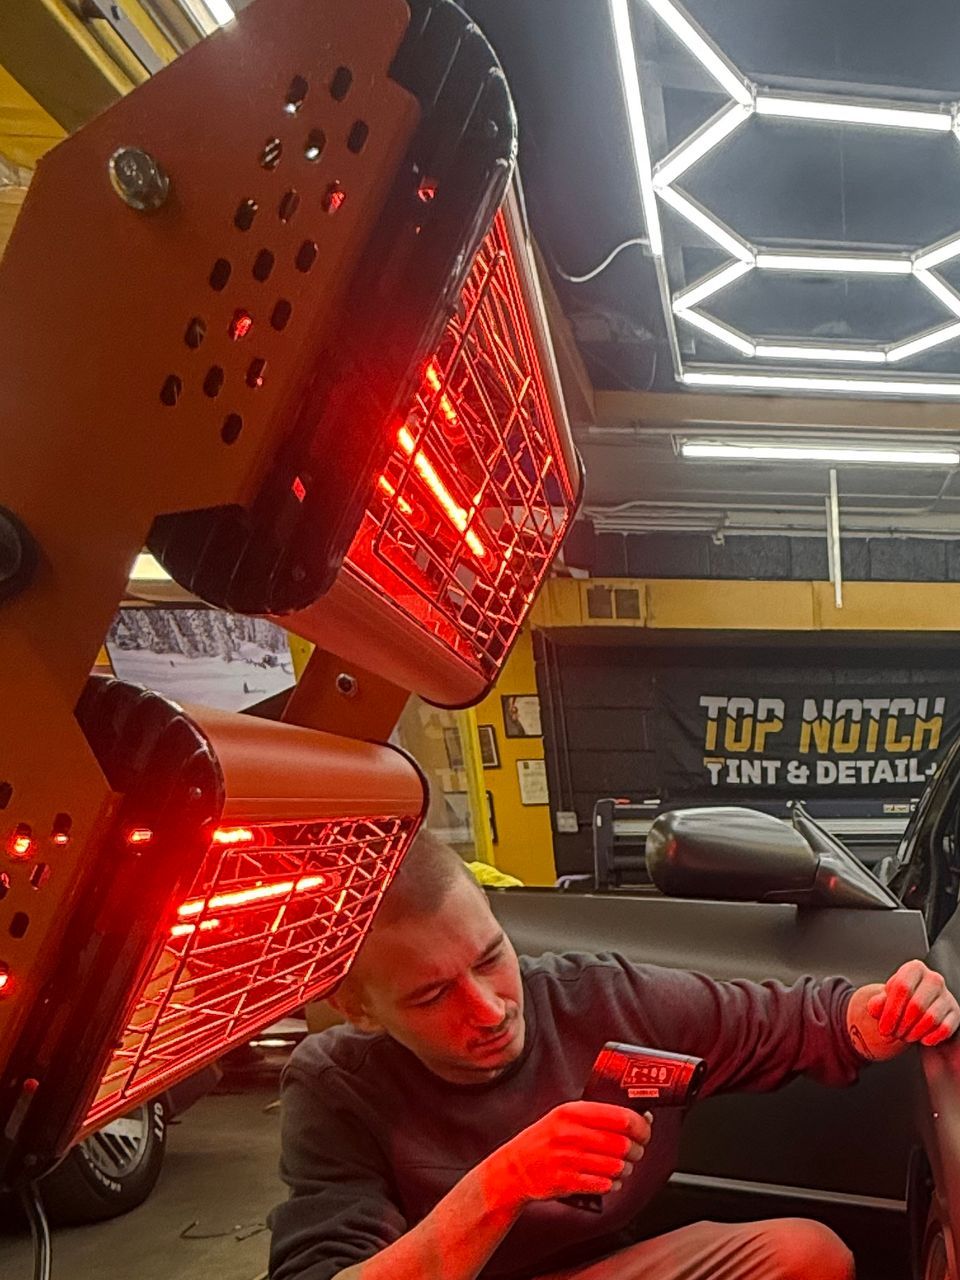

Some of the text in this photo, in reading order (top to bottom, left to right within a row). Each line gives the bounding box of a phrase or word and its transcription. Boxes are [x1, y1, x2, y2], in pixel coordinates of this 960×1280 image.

[699, 696, 946, 753] TOP NOTCH
[703, 757, 781, 786] TINT
[786, 760, 810, 784] &
